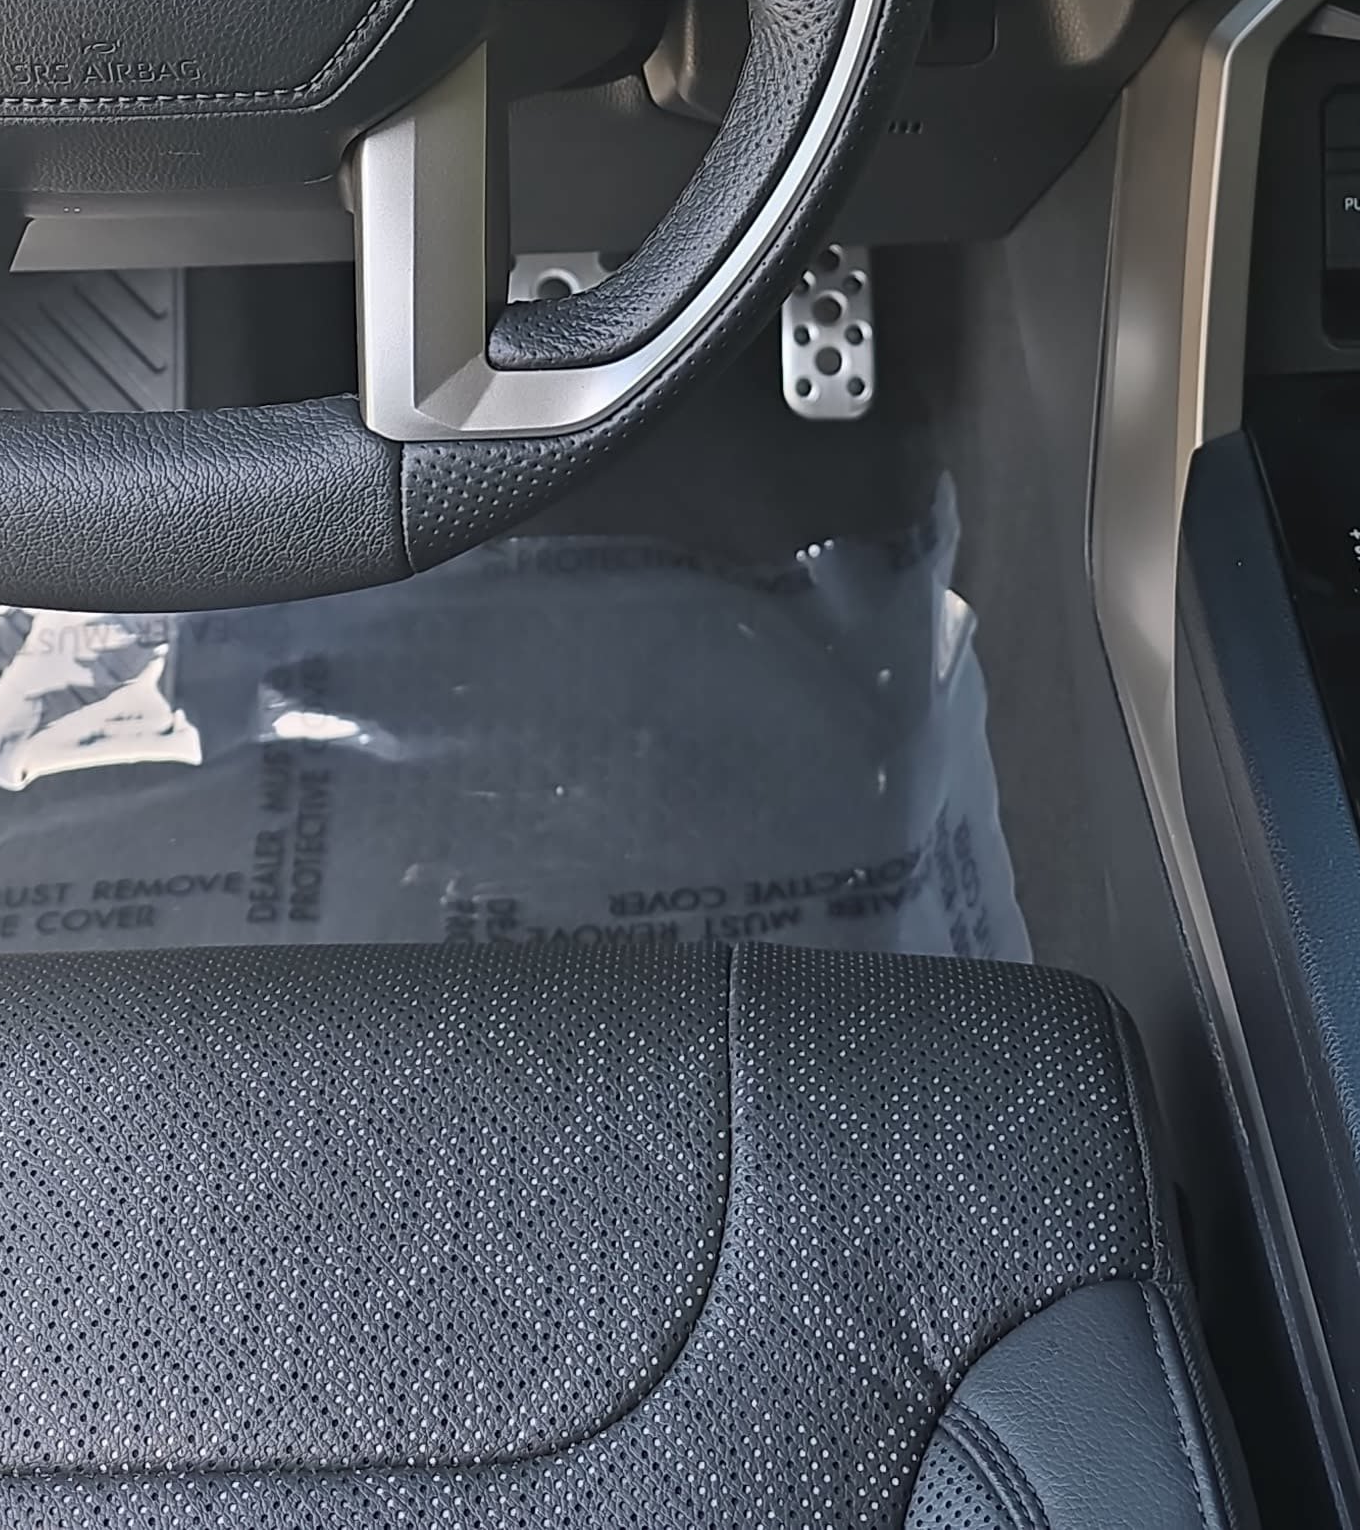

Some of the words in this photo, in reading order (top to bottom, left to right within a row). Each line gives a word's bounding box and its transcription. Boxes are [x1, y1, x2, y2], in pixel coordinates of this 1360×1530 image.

[13, 62, 72, 86] SRS
[82, 59, 203, 84] AIRBAG
[91, 871, 239, 901] REMOVE
[246, 828, 285, 925] DEALER
[608, 884, 727, 916] COVER
[35, 905, 156, 932] COVER
[704, 904, 804, 940] MUST
